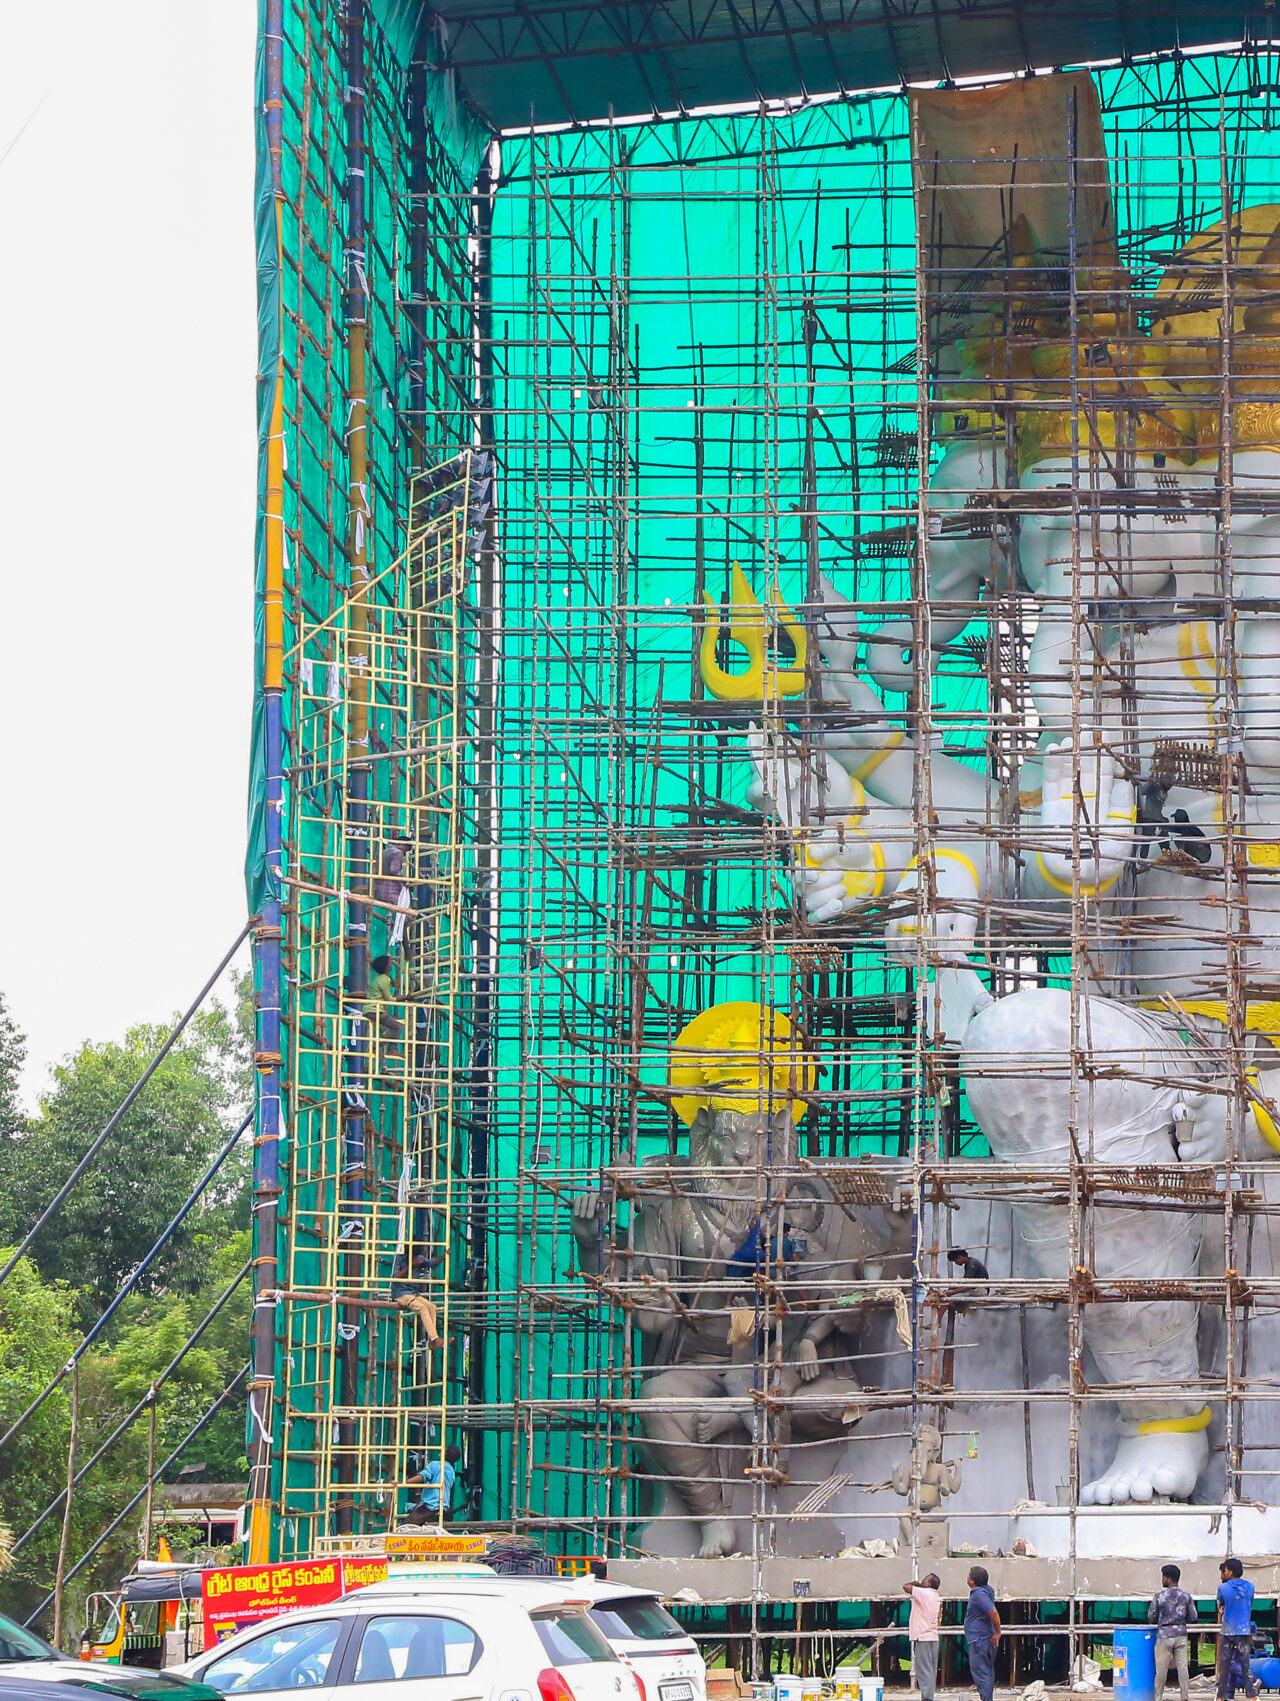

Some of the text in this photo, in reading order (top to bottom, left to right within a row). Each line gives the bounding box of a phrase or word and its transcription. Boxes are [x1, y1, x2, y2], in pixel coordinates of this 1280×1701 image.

[408, 1540, 419, 1552] ఓం
[207, 1564, 335, 1597] గ్రేట్ ఆంధ్ర రైస్ కంపెనీ
